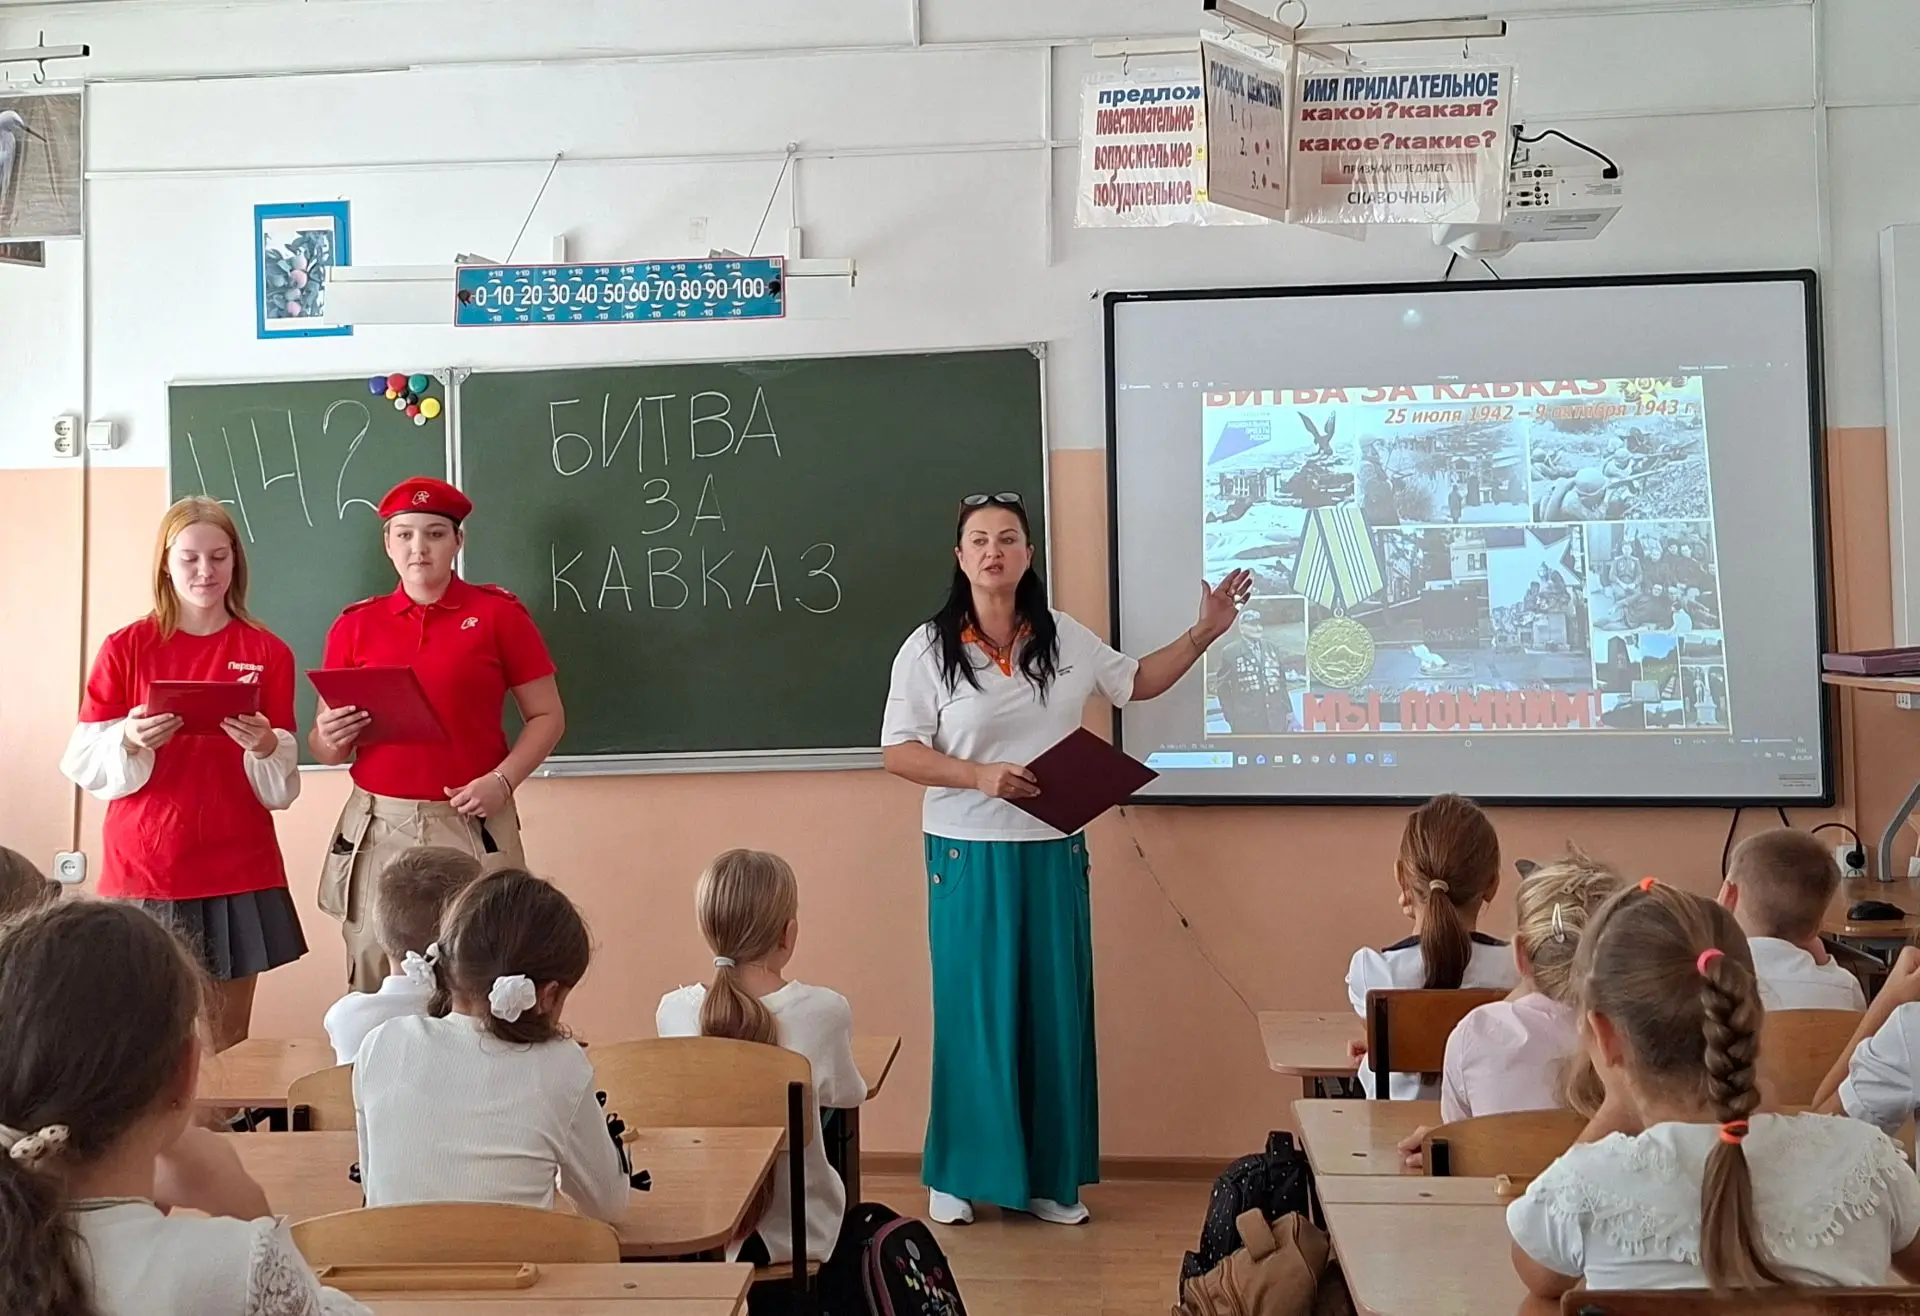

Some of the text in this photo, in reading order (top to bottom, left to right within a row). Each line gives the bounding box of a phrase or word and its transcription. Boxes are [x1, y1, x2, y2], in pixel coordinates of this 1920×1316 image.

[1303, 72, 1499, 102] ИМЯ ПРИЛАГАТЕЛЬНОЕ
[1096, 105, 1194, 135] повествовательное
[1094, 142, 1192, 172] вопросительное
[1395, 163, 1453, 175] ПРЕДМЕТА
[1093, 171, 1192, 214] побудительное
[475, 278, 764, 306] 0 10 20 30 40 50 60 70 80 90 100
[1384, 409, 1406, 424] 25
[1412, 408, 1462, 423] июля
[1469, 404, 1513, 421] 1942
[1536, 403, 1546, 419] 9
[1635, 400, 1678, 416] 1943
[550, 386, 781, 476] БИТВА
[641, 473, 725, 536] ЗА
[551, 543, 841, 613] КАВКАЗ
[1303, 692, 1380, 731] МЫ
